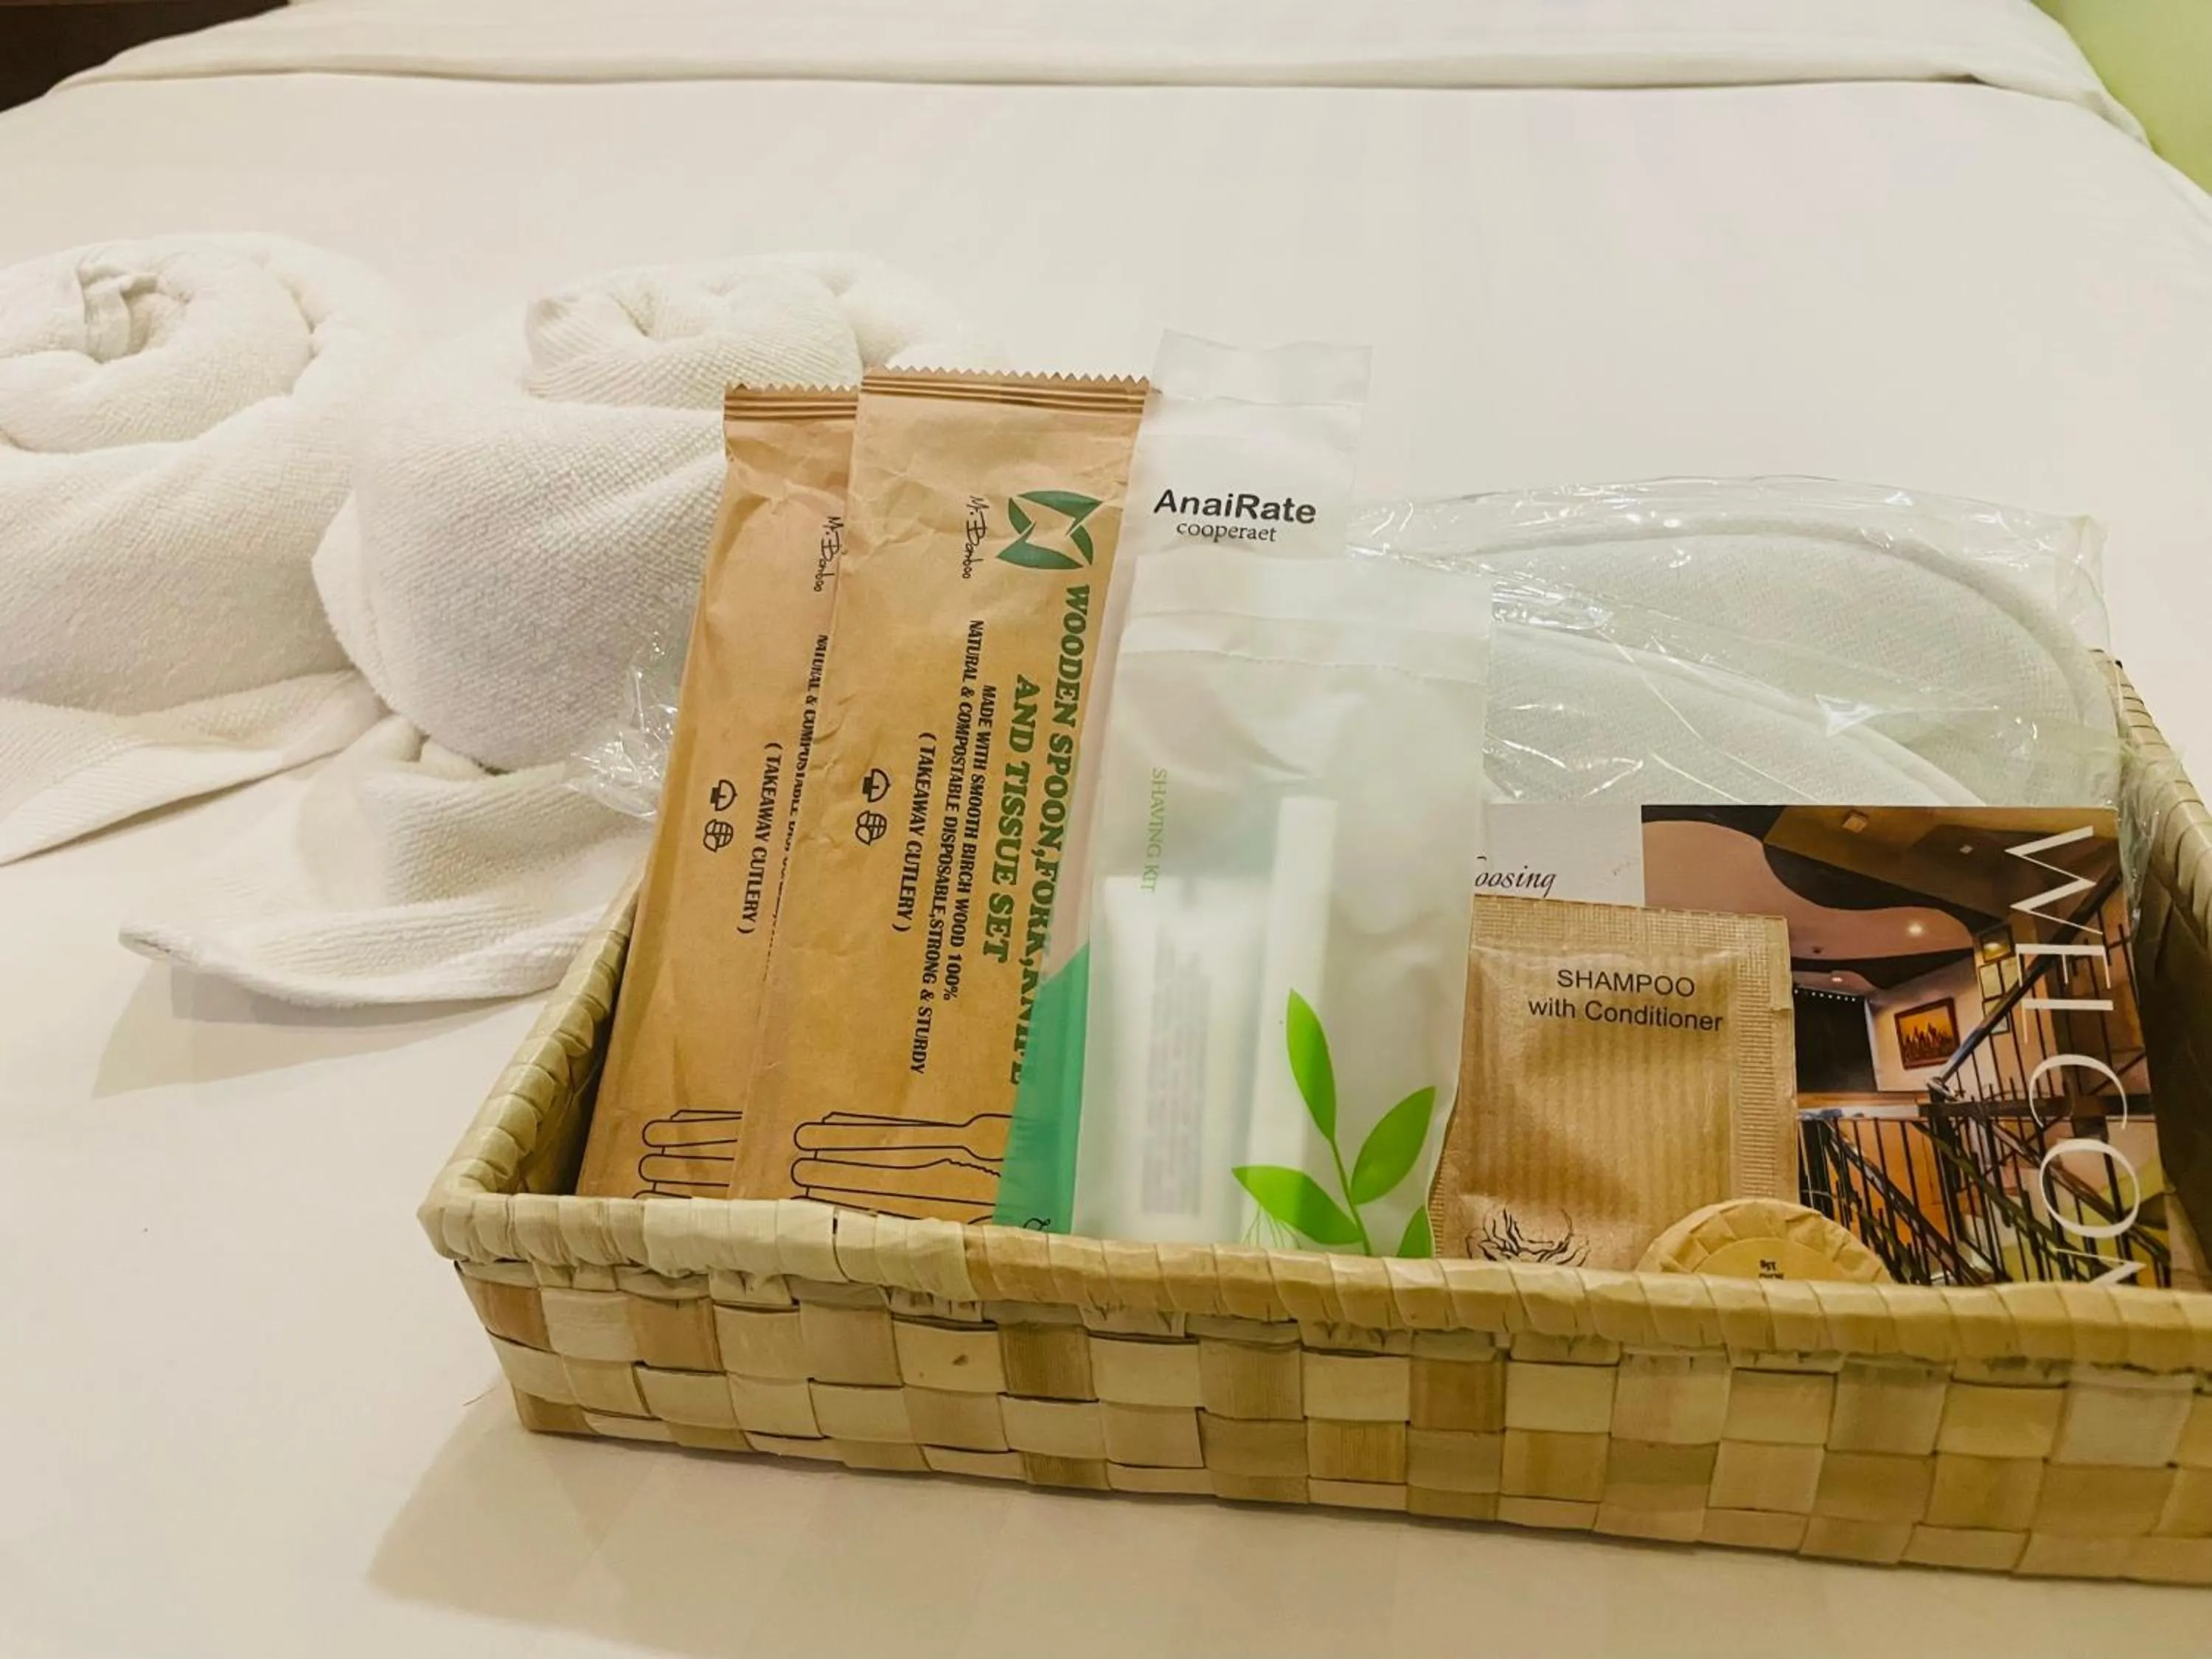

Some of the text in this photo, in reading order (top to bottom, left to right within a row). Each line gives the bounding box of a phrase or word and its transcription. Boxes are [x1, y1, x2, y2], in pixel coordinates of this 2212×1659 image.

[1153, 489, 1316, 524] AnaiRate
[962, 620, 985, 688] NATURAL
[1051, 584, 1090, 728] WOODEN
[960, 687, 973, 698] &
[945, 701, 973, 812] COMPOSTABLE
[942, 685, 997, 1001] MADE WITH SMOOTH BIRCH WOOD 100%
[982, 674, 1040, 964] AND TISSUE SET
[1141, 768, 1169, 894] SHAVING KIT
[1475, 856, 1557, 898] oosing
[919, 989, 934, 1002] &
[1528, 998, 1724, 1032] with Conditioner
[1557, 969, 1695, 998] SHAMPOO
[910, 1006, 933, 1074] STURDY
